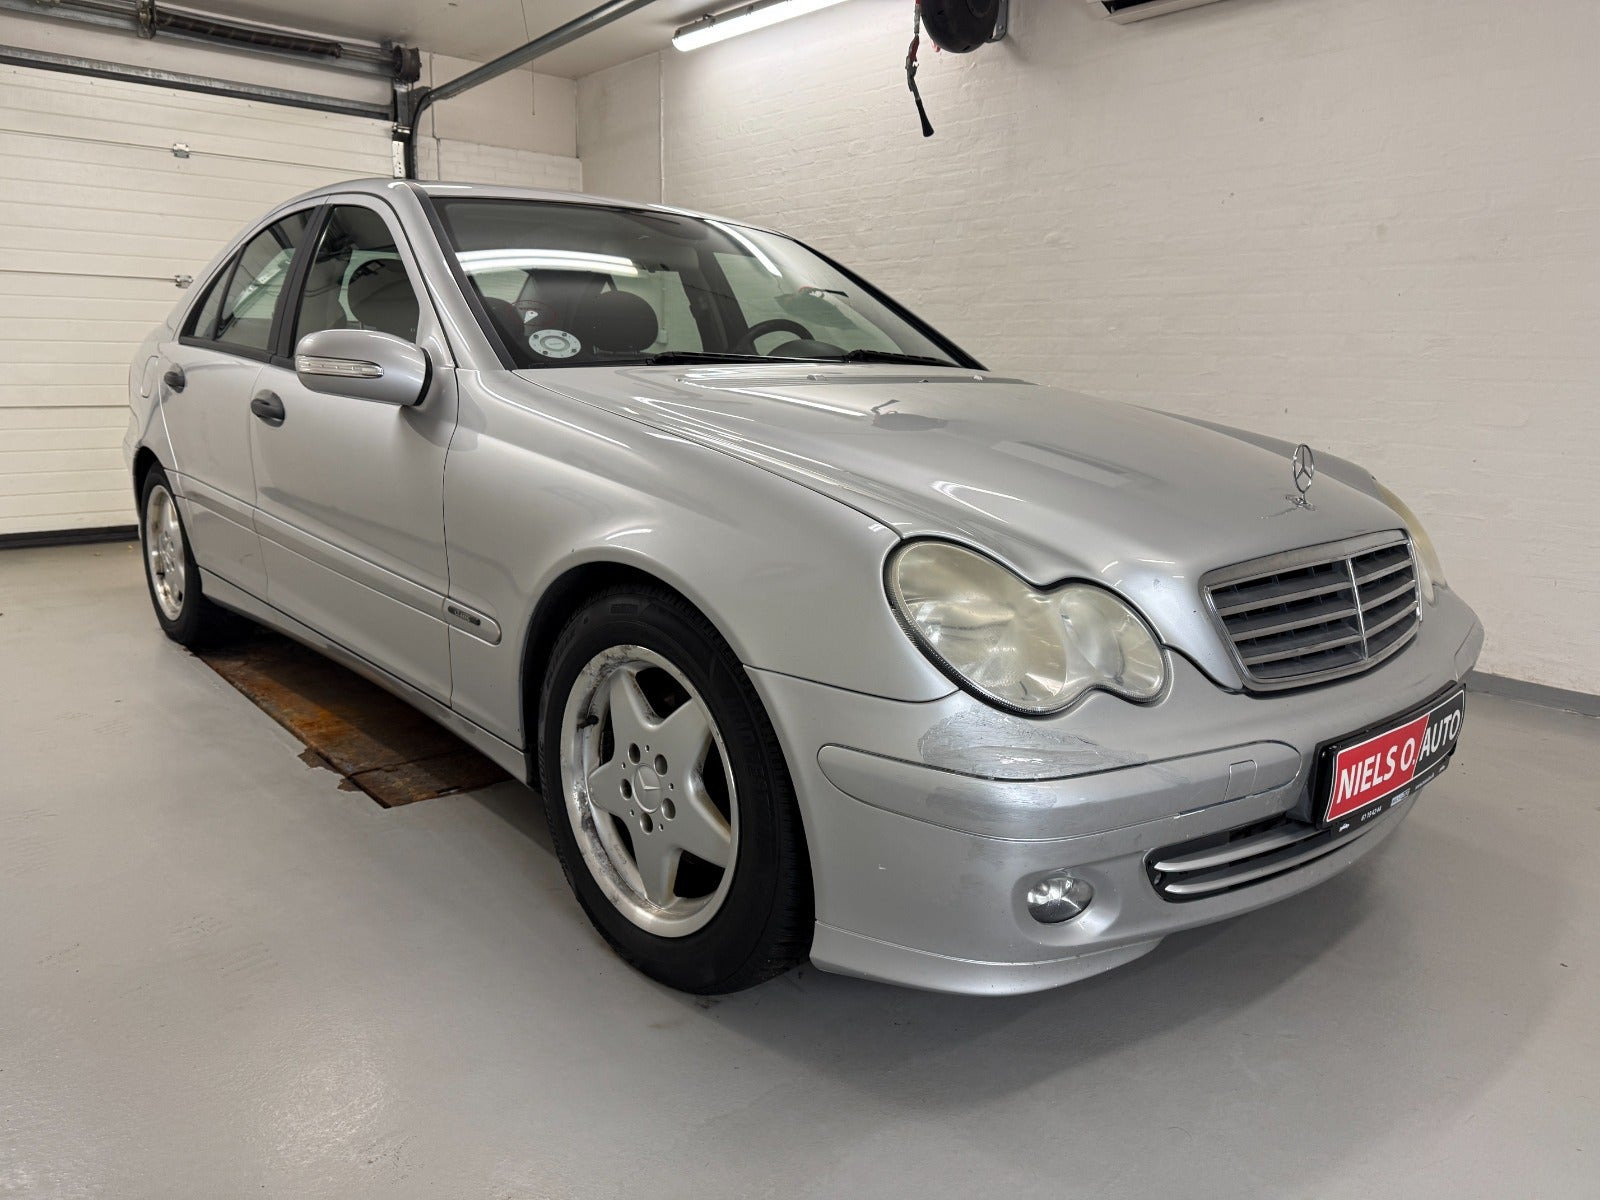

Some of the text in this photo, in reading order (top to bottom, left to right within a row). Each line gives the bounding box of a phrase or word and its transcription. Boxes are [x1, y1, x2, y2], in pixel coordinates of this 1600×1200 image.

[1336, 709, 1461, 804] NIELS O. AUTO
